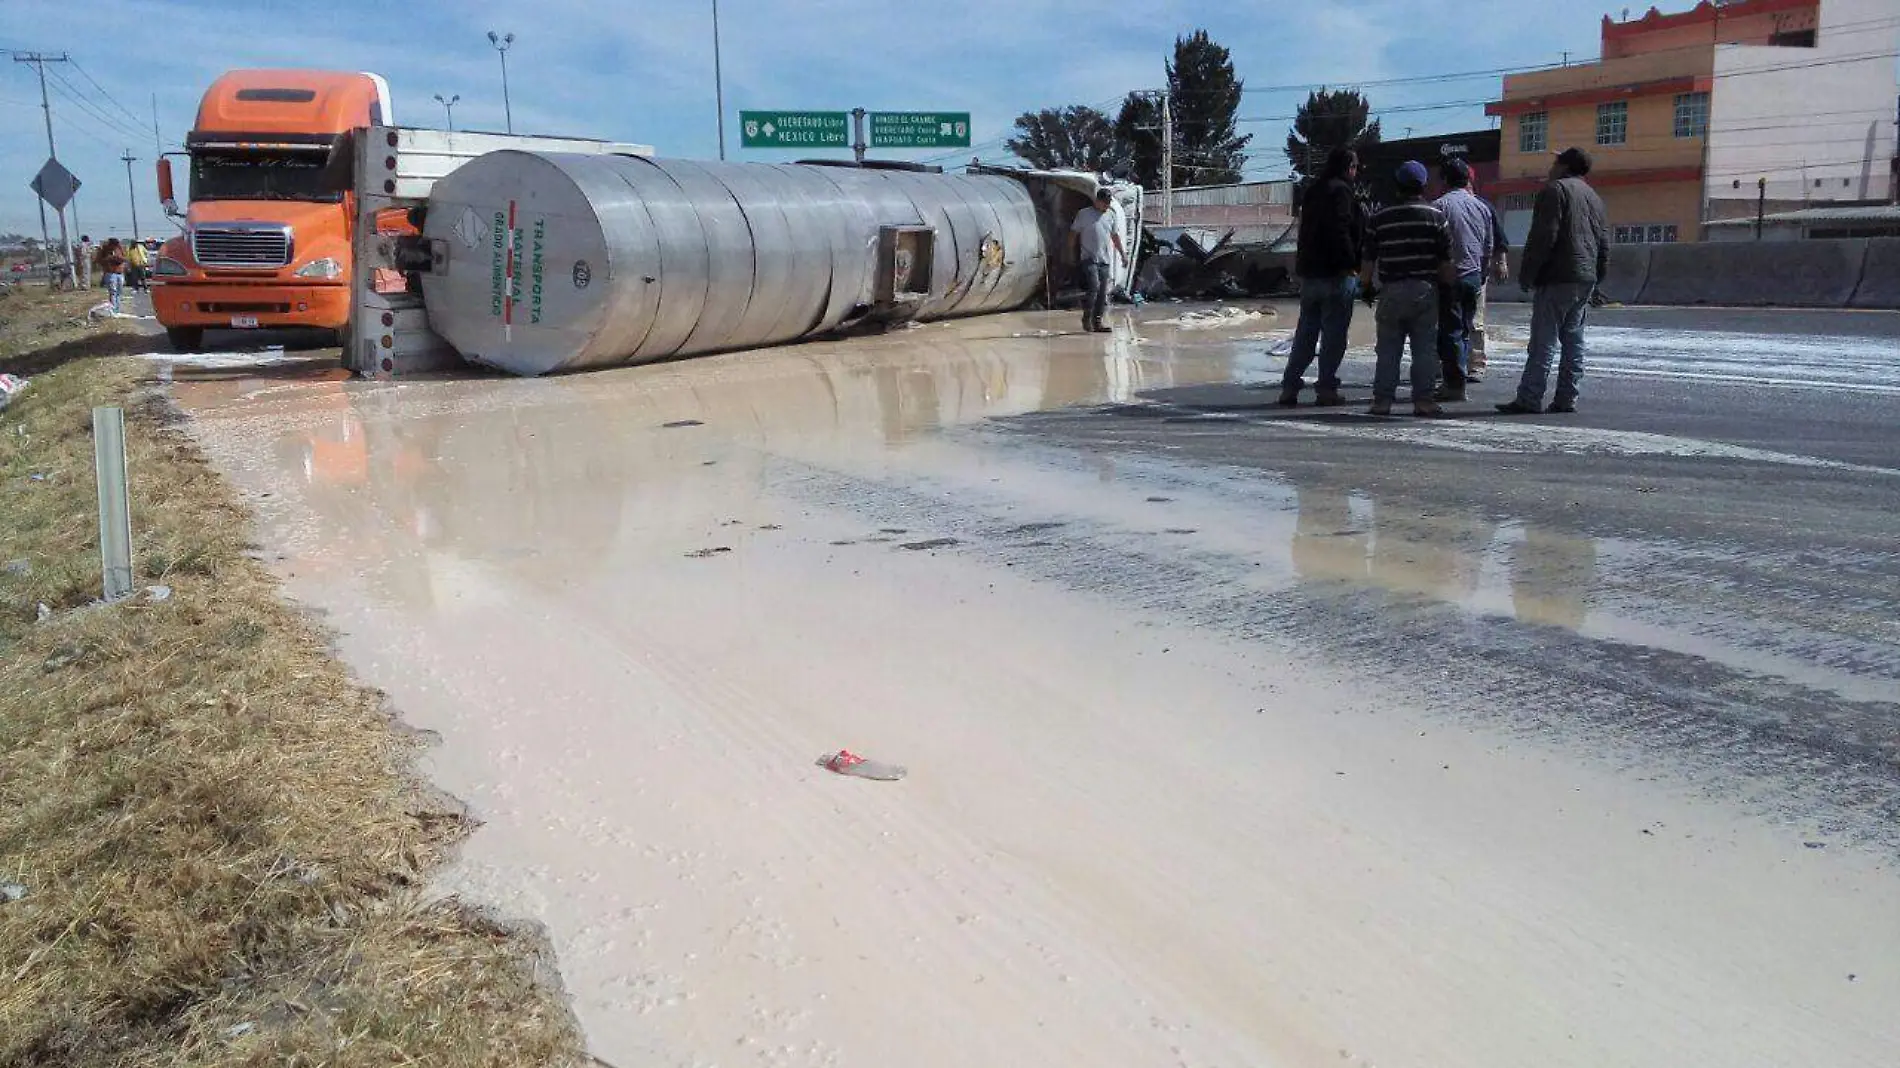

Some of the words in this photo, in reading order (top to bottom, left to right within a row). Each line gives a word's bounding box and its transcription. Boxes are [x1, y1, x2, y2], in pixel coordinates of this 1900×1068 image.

[778, 131, 814, 142] MEXICO
[820, 132, 845, 142] Libre
[824, 117, 844, 128] Libre
[493, 211, 504, 248] GRADO
[492, 251, 503, 316] ALIMENTICIO
[512, 228, 524, 307] MATERIAL
[531, 219, 544, 324] TRANSPORTA
